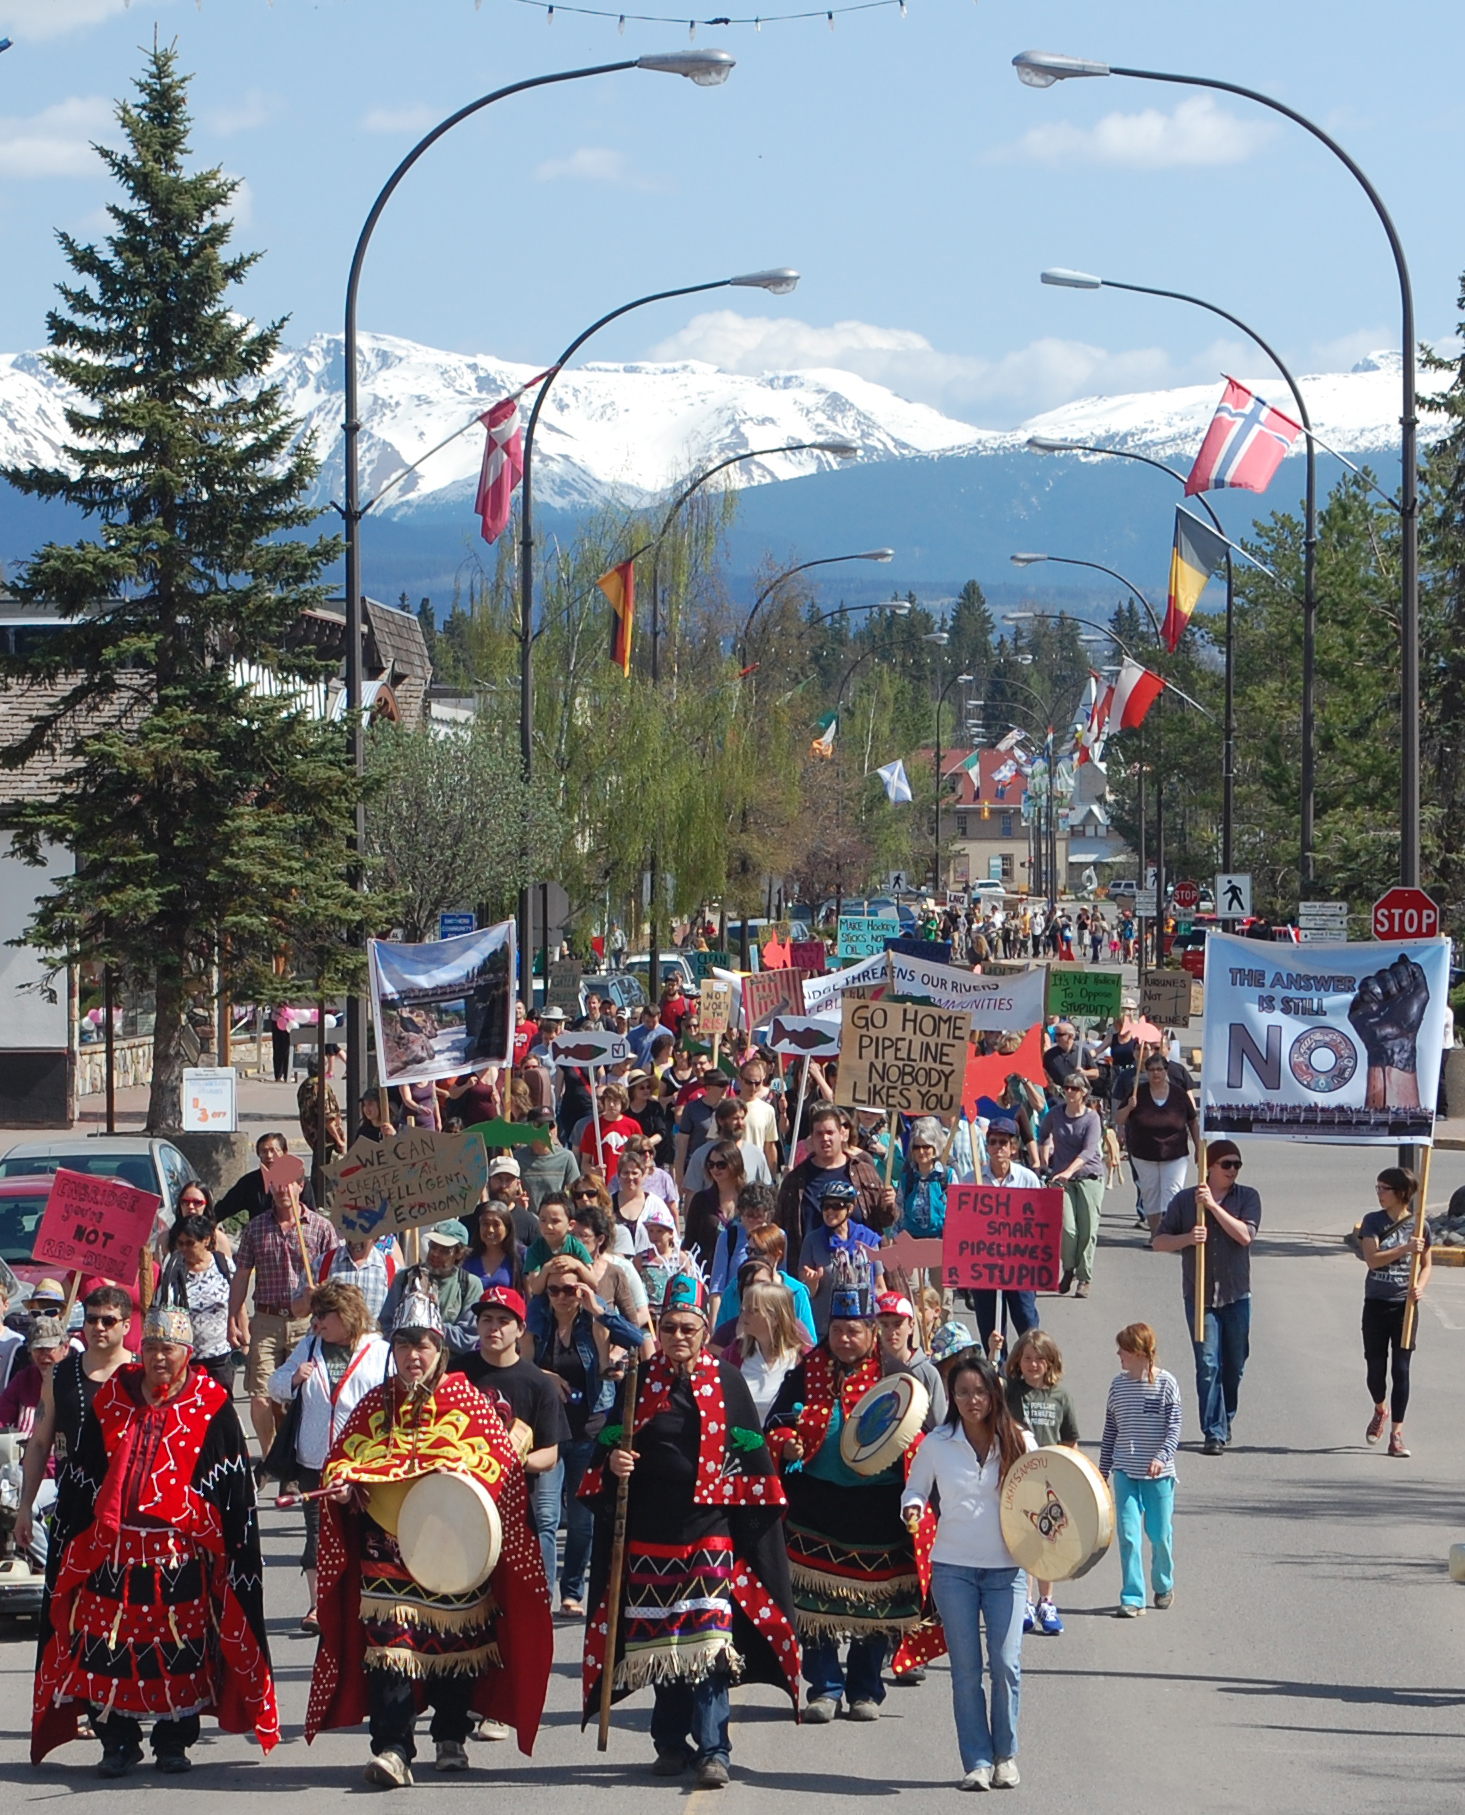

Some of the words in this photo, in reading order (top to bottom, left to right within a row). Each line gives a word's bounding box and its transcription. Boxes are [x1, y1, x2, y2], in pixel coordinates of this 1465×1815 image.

[1174, 891, 1198, 900] STOP
[840, 919, 863, 931] MAKE
[867, 920, 896, 933] HOCKEY
[1376, 908, 1436, 933] STOP
[845, 945, 861, 956] OIL
[871, 934, 886, 943] NOT
[697, 953, 727, 965] CLEAN
[844, 965, 916, 987] THREAENS
[921, 973, 948, 992] OUR
[1051, 973, 1069, 986] It's
[1073, 974, 1089, 985] Not
[1141, 971, 1187, 988] TURBINES
[1229, 968, 1266, 987] THE
[1270, 972, 1356, 993] ANSWER
[706, 991, 726, 1000] NOT
[1061, 987, 1074, 998] To
[1080, 987, 1112, 1002] Oppose
[1258, 994, 1275, 1013] IS
[1280, 996, 1327, 1016] STILL
[1061, 1000, 1113, 1018] STUPIDITY
[851, 1005, 888, 1031] GO
[902, 1008, 966, 1040] HOME
[858, 1034, 956, 1066] PIPELINE
[1227, 1023, 1358, 1093] NO
[868, 1061, 955, 1092] NOBODY
[851, 1080, 911, 1110] LIKES
[917, 1089, 954, 1111] YOU
[356, 1150, 386, 1168] WE
[393, 1136, 435, 1160] CAN
[346, 1169, 399, 1194] CREATE
[419, 1163, 438, 1178] AN
[57, 1178, 140, 1213] ENBRIDGE
[394, 1192, 469, 1224] ECONOMY
[957, 1192, 1011, 1217] FISH
[1022, 1202, 1035, 1217] R
[73, 1224, 115, 1249] NOT
[987, 1219, 1050, 1240] SMART
[42, 1238, 75, 1261] RAD
[82, 1250, 128, 1278] DUDE
[959, 1239, 1054, 1262] PIPELINES
[948, 1266, 960, 1280] R
[970, 1262, 1054, 1288] STUPID
